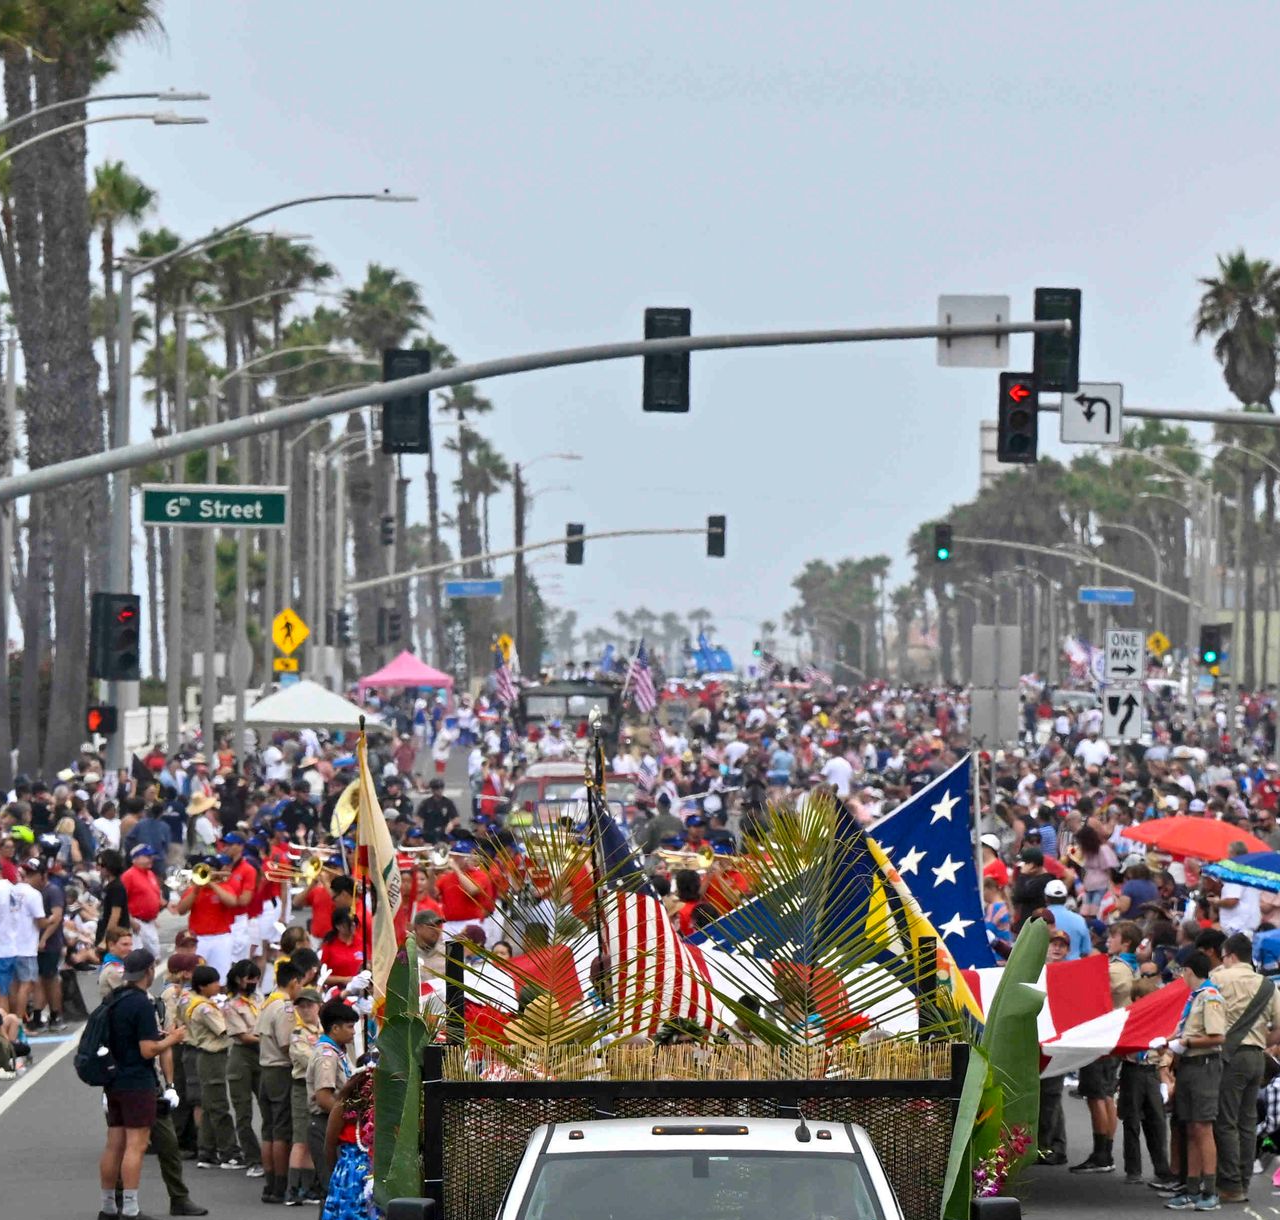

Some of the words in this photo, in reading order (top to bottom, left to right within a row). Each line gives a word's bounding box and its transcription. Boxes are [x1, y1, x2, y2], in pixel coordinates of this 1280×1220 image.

[165, 497, 191, 517] 6th
[199, 499, 263, 518] Street
[1112, 633, 1138, 646] ONE
[1111, 648, 1138, 660] WAY
